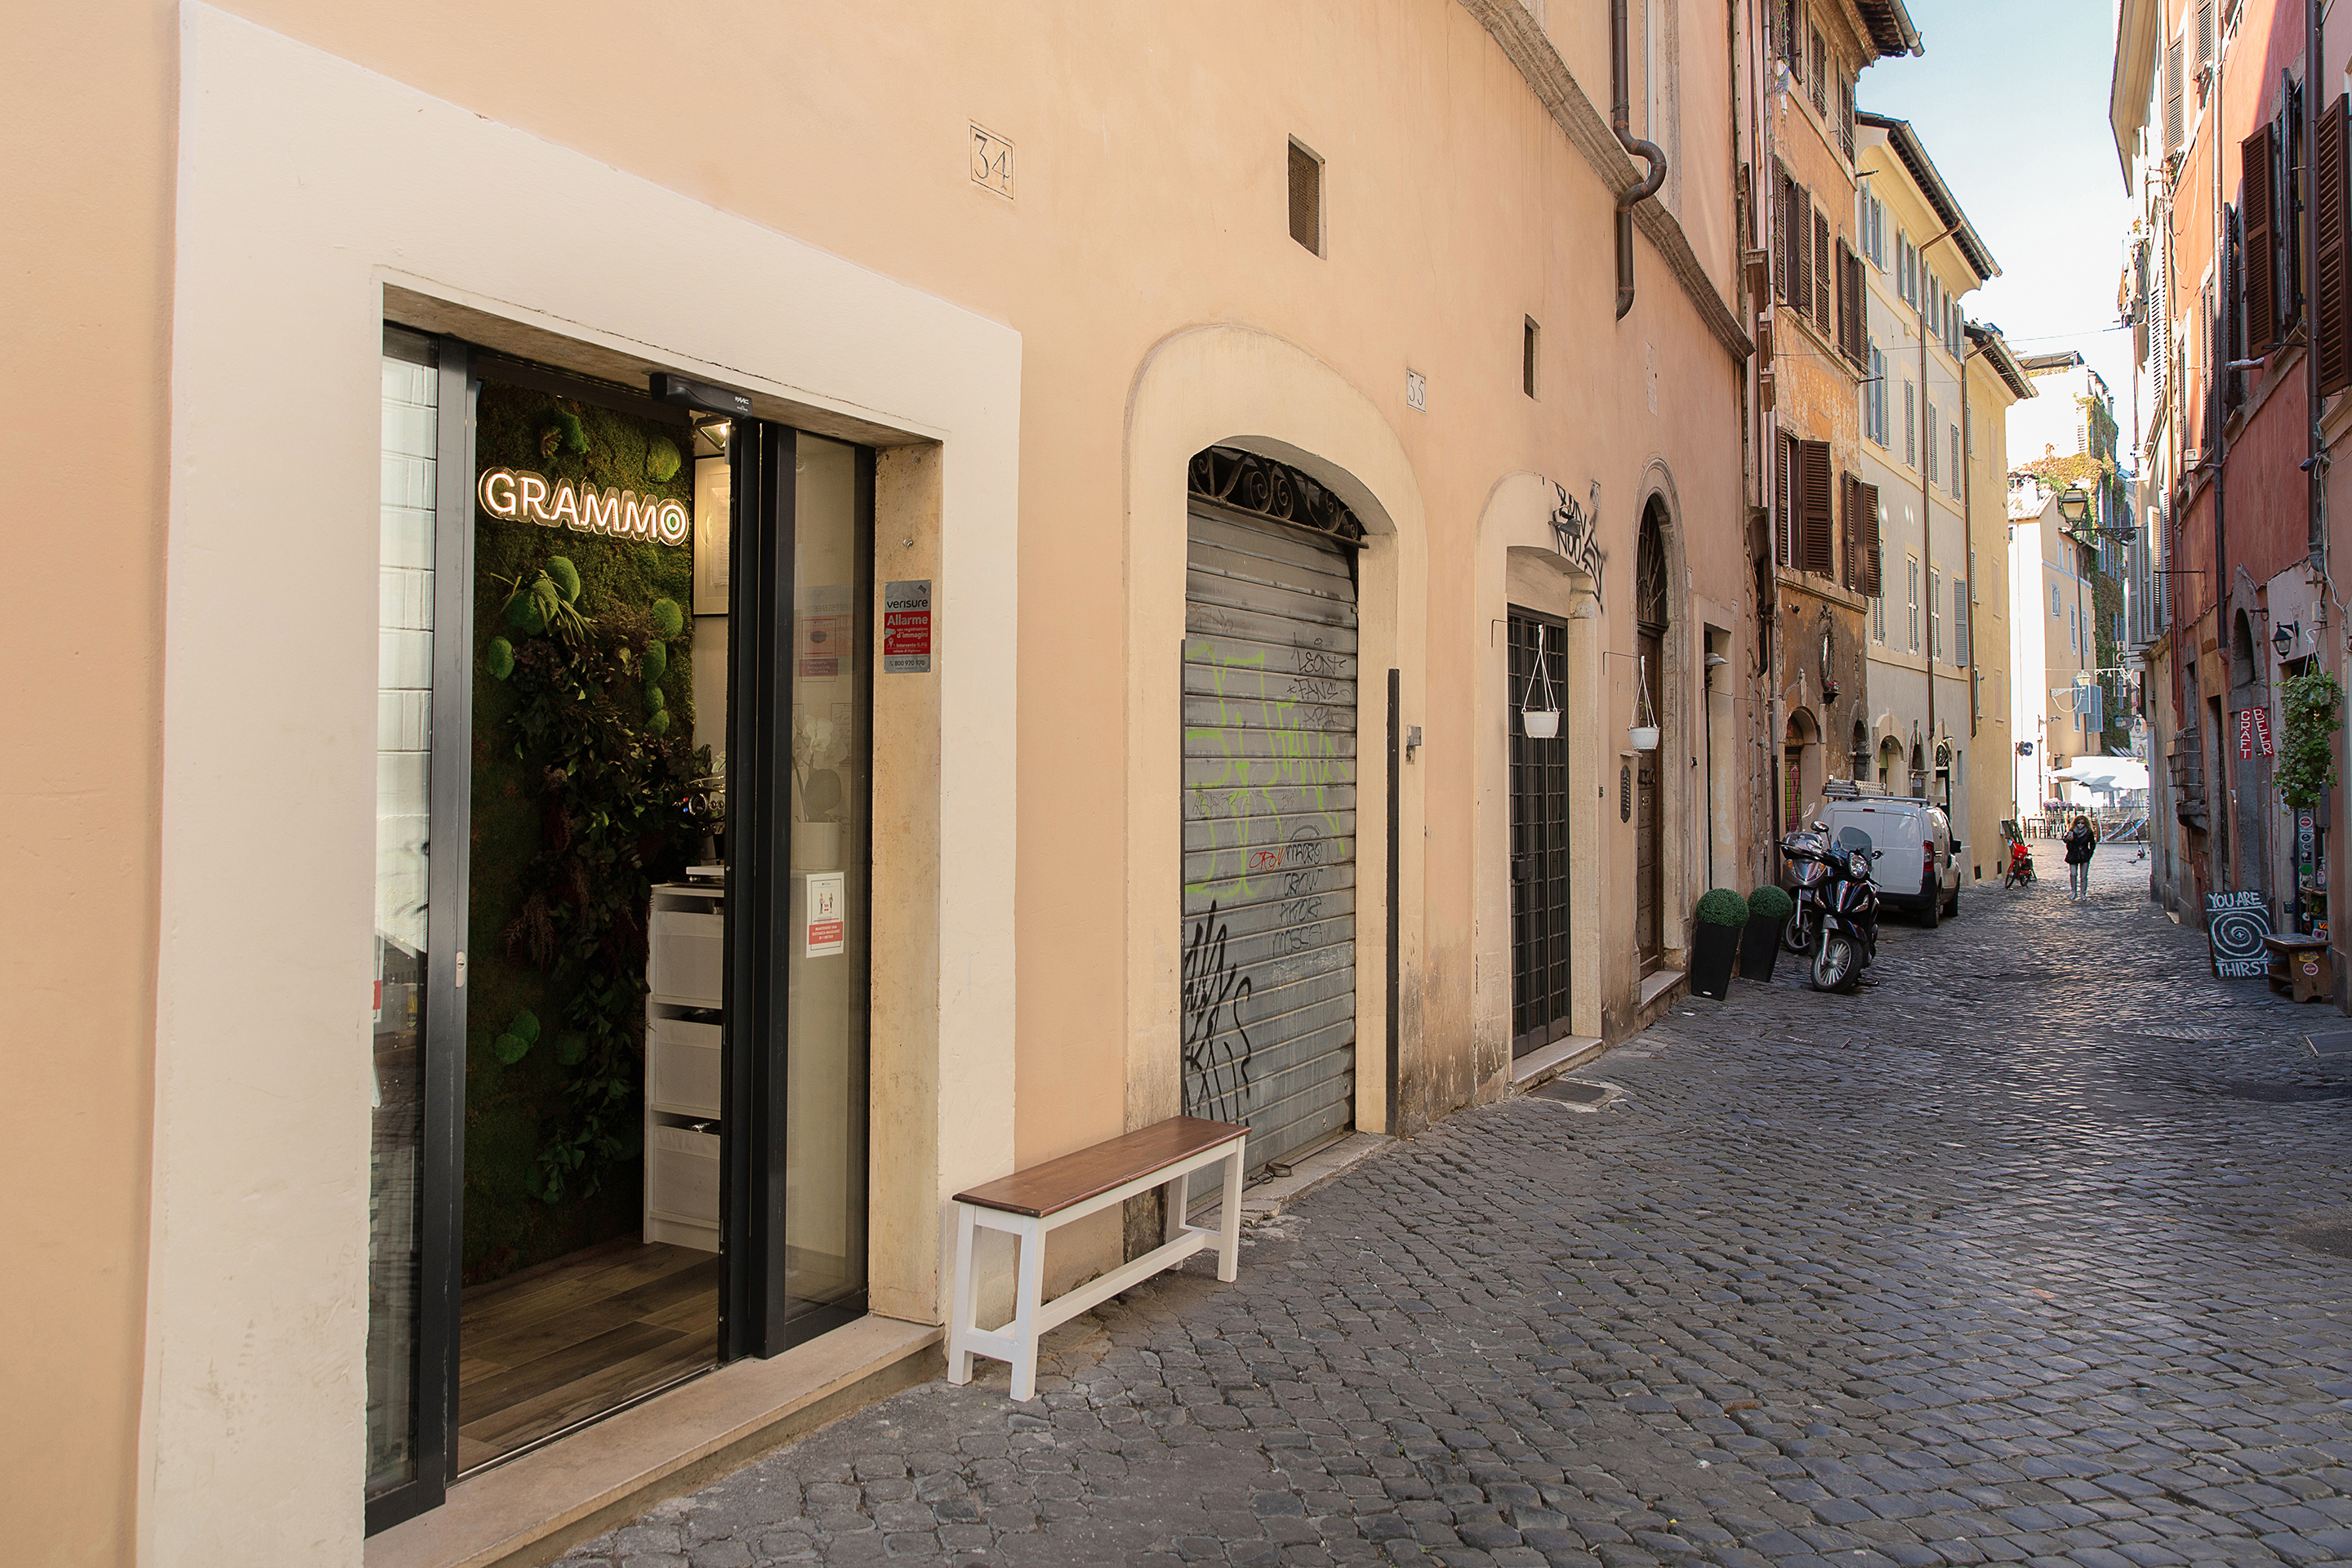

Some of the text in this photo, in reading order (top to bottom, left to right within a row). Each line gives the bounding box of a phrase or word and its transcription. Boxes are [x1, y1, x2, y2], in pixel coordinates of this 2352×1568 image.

[973, 133, 1010, 191] 34
[1408, 372, 1424, 406] 35
[483, 471, 688, 541] GRAMMO
[886, 599, 929, 609] verisure
[886, 613, 929, 626] Allarme
[2240, 710, 2251, 759] CRAFT
[2253, 708, 2273, 755] BEER
[2207, 890, 2263, 909] YOU ARE
[2215, 960, 2270, 978] THIRST
